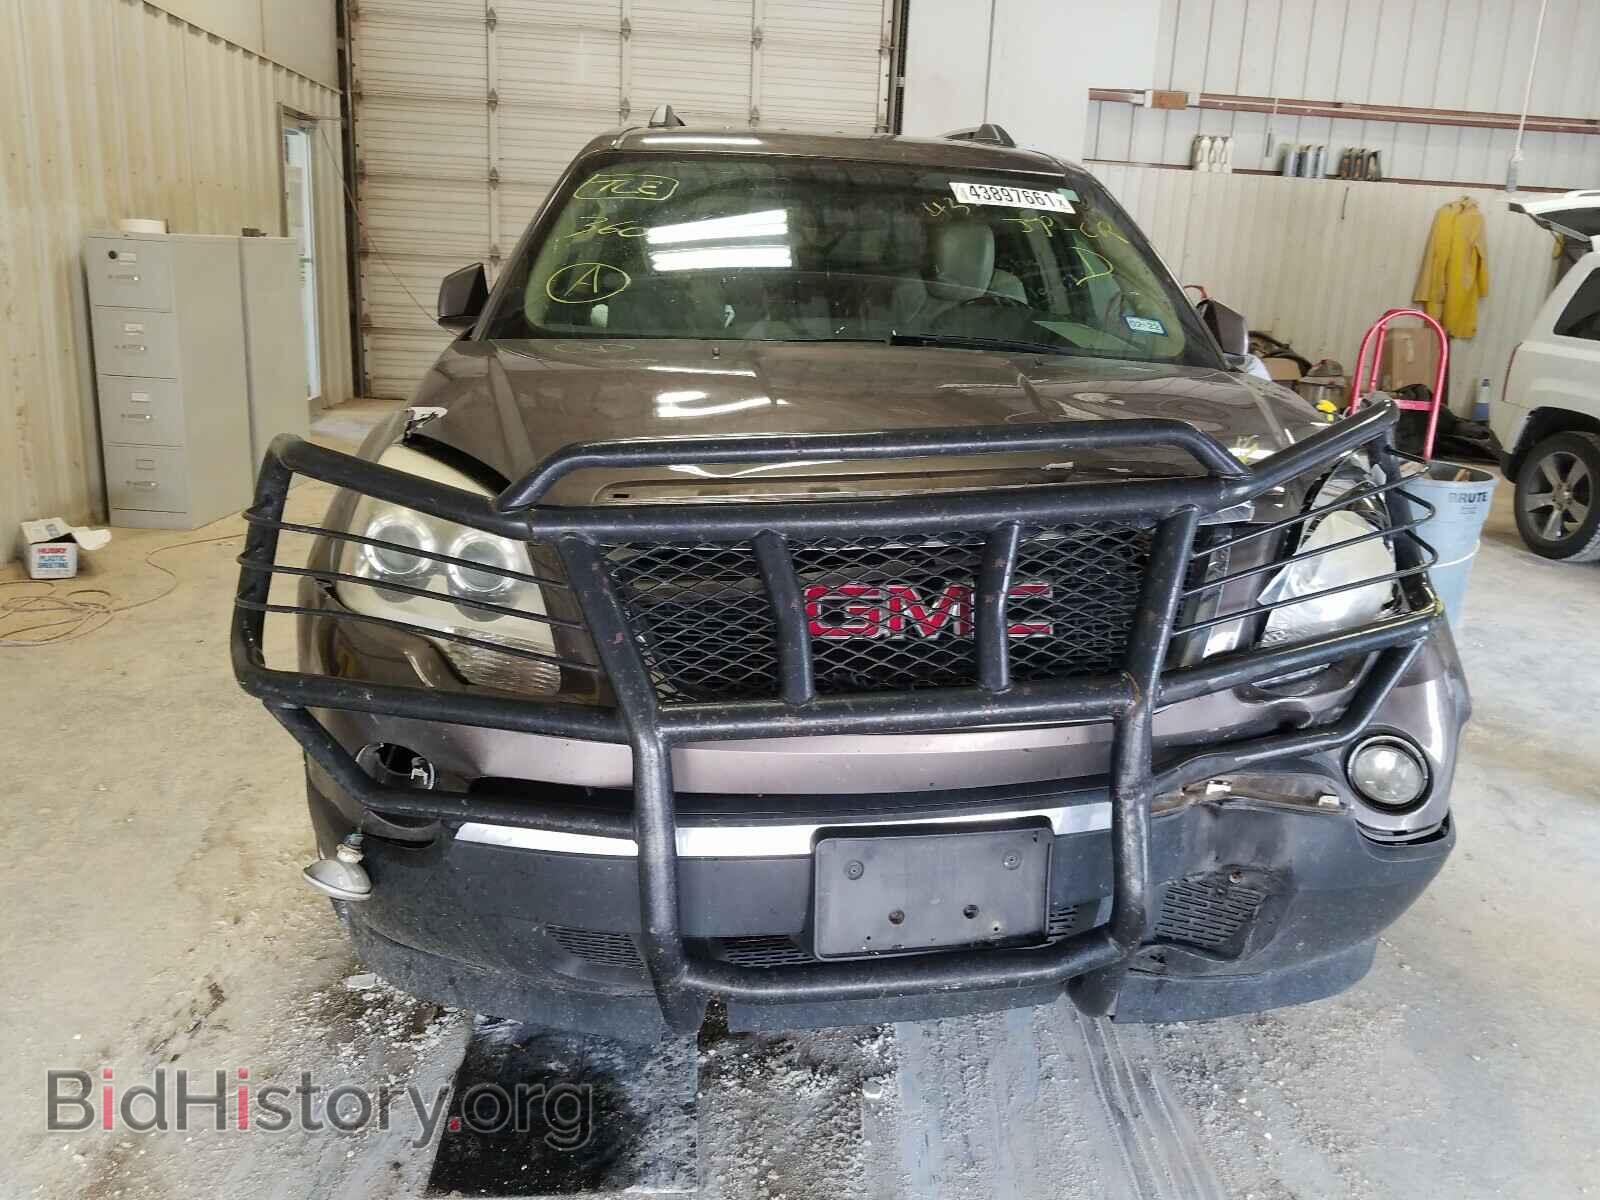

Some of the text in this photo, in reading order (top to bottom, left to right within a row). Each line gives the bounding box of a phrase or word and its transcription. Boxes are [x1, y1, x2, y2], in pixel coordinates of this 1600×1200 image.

[969, 184, 1057, 208] 43897661
[564, 263, 601, 297] A
[803, 582, 1054, 640] GMC
